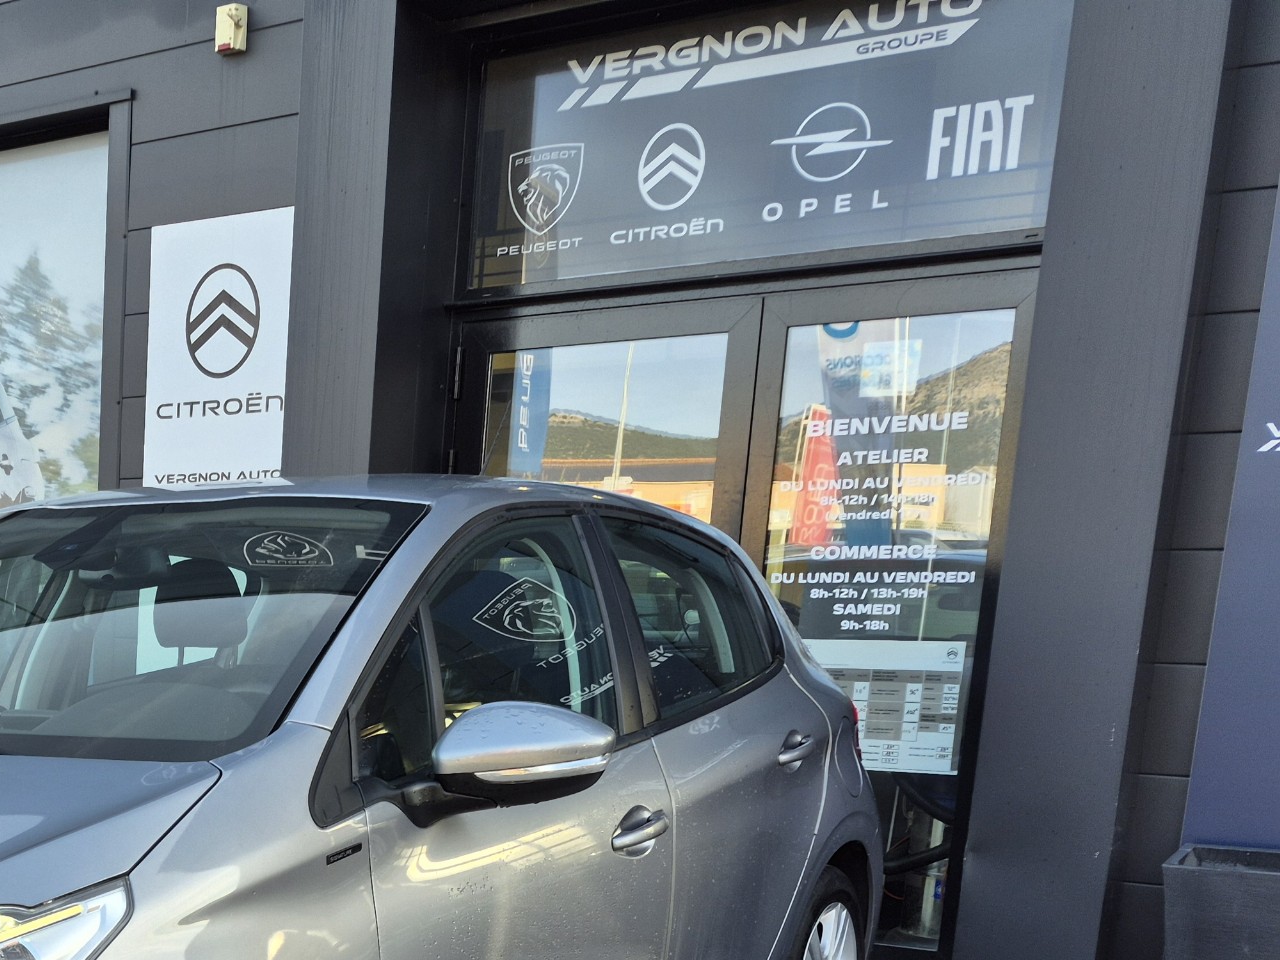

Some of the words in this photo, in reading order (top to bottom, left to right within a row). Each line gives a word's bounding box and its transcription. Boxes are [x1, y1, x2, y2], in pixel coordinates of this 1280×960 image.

[568, 16, 807, 85] VERGNON
[821, 0, 982, 41] AUTO
[855, 29, 949, 55] GROUPE
[926, 94, 1035, 181] FIAT
[515, 150, 578, 167] PEUGEOT
[762, 189, 889, 222] OPEL
[496, 237, 583, 257] PEUGEOT
[805, 411, 970, 437] BIENVENUE
[836, 448, 929, 466] ATELIER
[154, 472, 231, 485] VERGNON
[236, 469, 281, 480] AUTO
[780, 480, 803, 492] DU
[808, 478, 858, 491] LUNDI
[862, 476, 888, 489] AU
[897, 472, 987, 487] VENDREDI
[820, 495, 868, 506] 8h-12h
[810, 545, 938, 560] COMMERCE
[771, 572, 795, 584] DU
[798, 572, 850, 584] LUNDI
[852, 572, 879, 583] AU
[883, 571, 976, 584] VENDREDI
[810, 588, 858, 599] 8h-12h
[860, 588, 868, 599] /
[871, 587, 928, 599] 13h-19h
[832, 603, 901, 615] SAMEDI
[840, 619, 889, 631] 9h-18h
